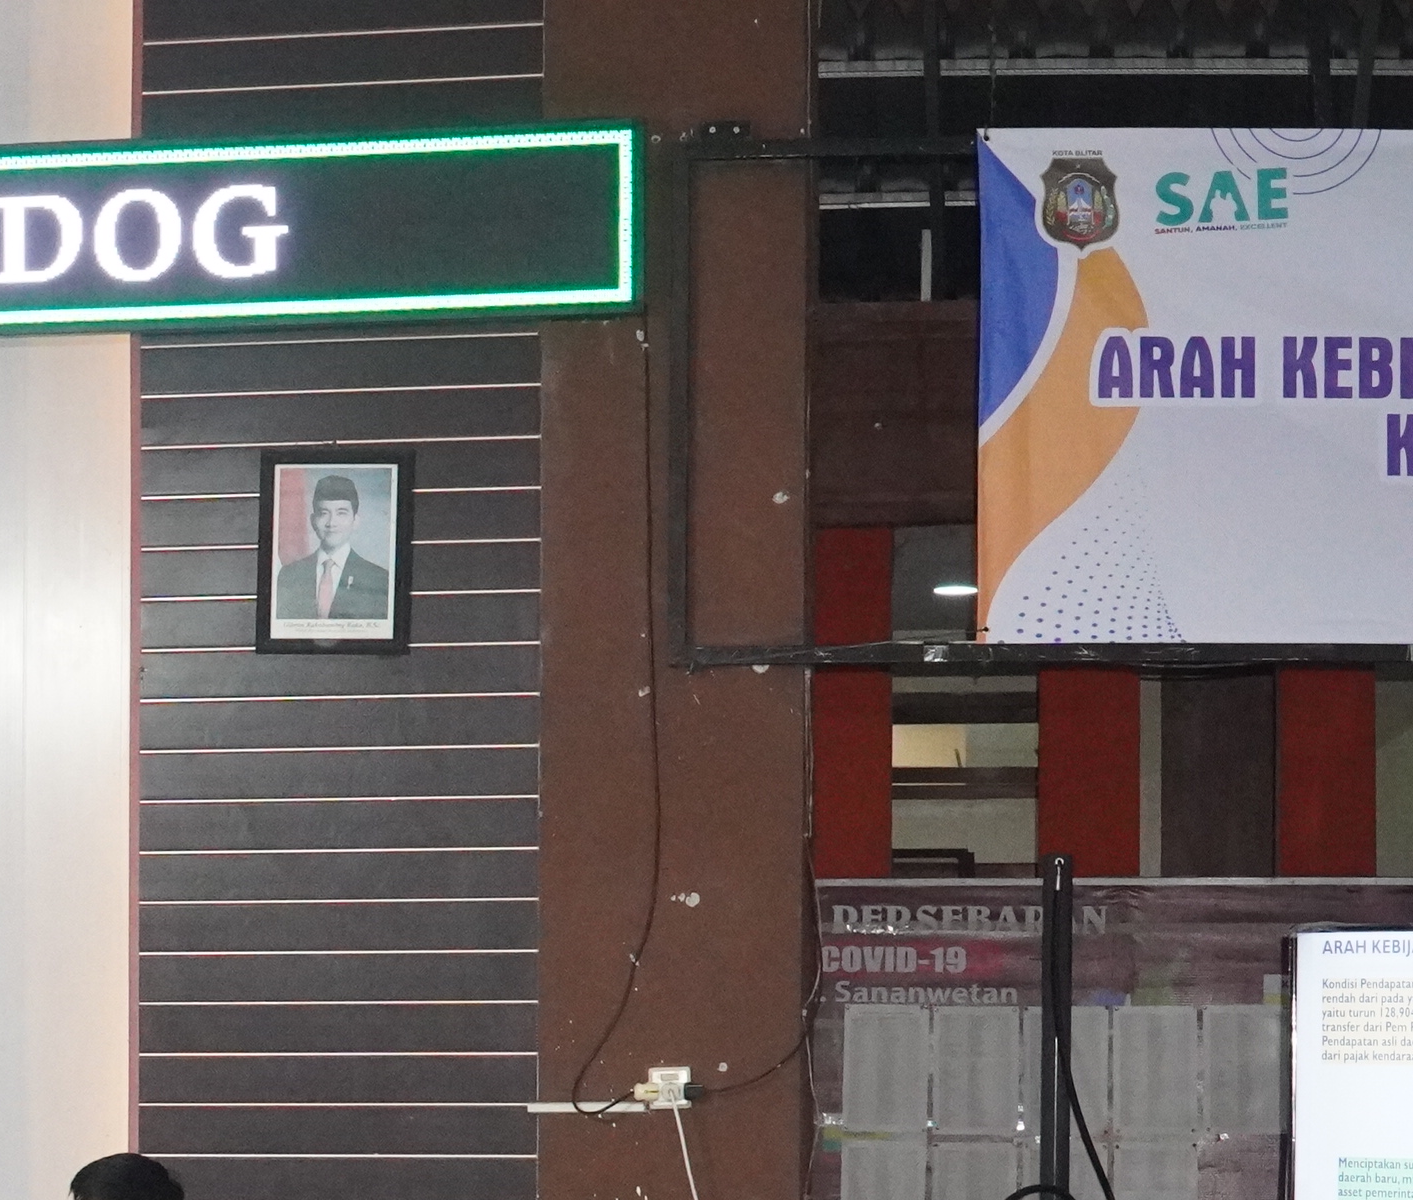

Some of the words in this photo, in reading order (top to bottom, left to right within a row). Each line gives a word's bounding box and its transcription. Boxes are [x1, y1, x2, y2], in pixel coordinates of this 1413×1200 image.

[1155, 167, 1289, 226] SAE
[1154, 226, 1193, 235] SANTUN,
[1195, 224, 1238, 233] AMANAH,
[1097, 335, 1256, 399] ARAH
[832, 904, 1108, 935] PERSEBARN
[1322, 940, 1367, 954] ARAH
[1372, 939, 1413, 957] KEBIJ
[822, 945, 967, 973] COVID-19
[1322, 978, 1357, 989] Kondisi
[835, 980, 1018, 1003] Sananwetan
[1322, 993, 1356, 1004] rendah
[1359, 993, 1378, 1004] dari
[1381, 993, 1404, 1006] pada
[1322, 1008, 1346, 1020] yaitu
[1348, 1009, 1376, 1018] turun
[1322, 1021, 1360, 1032] transfer
[1363, 1021, 1382, 1032] dari
[1386, 1021, 1407, 1032] Pem
[1322, 1035, 1379, 1049] Pendapatan
[1381, 1036, 1397, 1047] asli
[1321, 1050, 1341, 1061] dari
[1343, 1050, 1369, 1063] pajak
[1338, 1157, 1401, 1171] Menciptakan
[1338, 1171, 1372, 1183] daerah
[1375, 1172, 1401, 1185] baru,
[1338, 1188, 1363, 1197] asset
